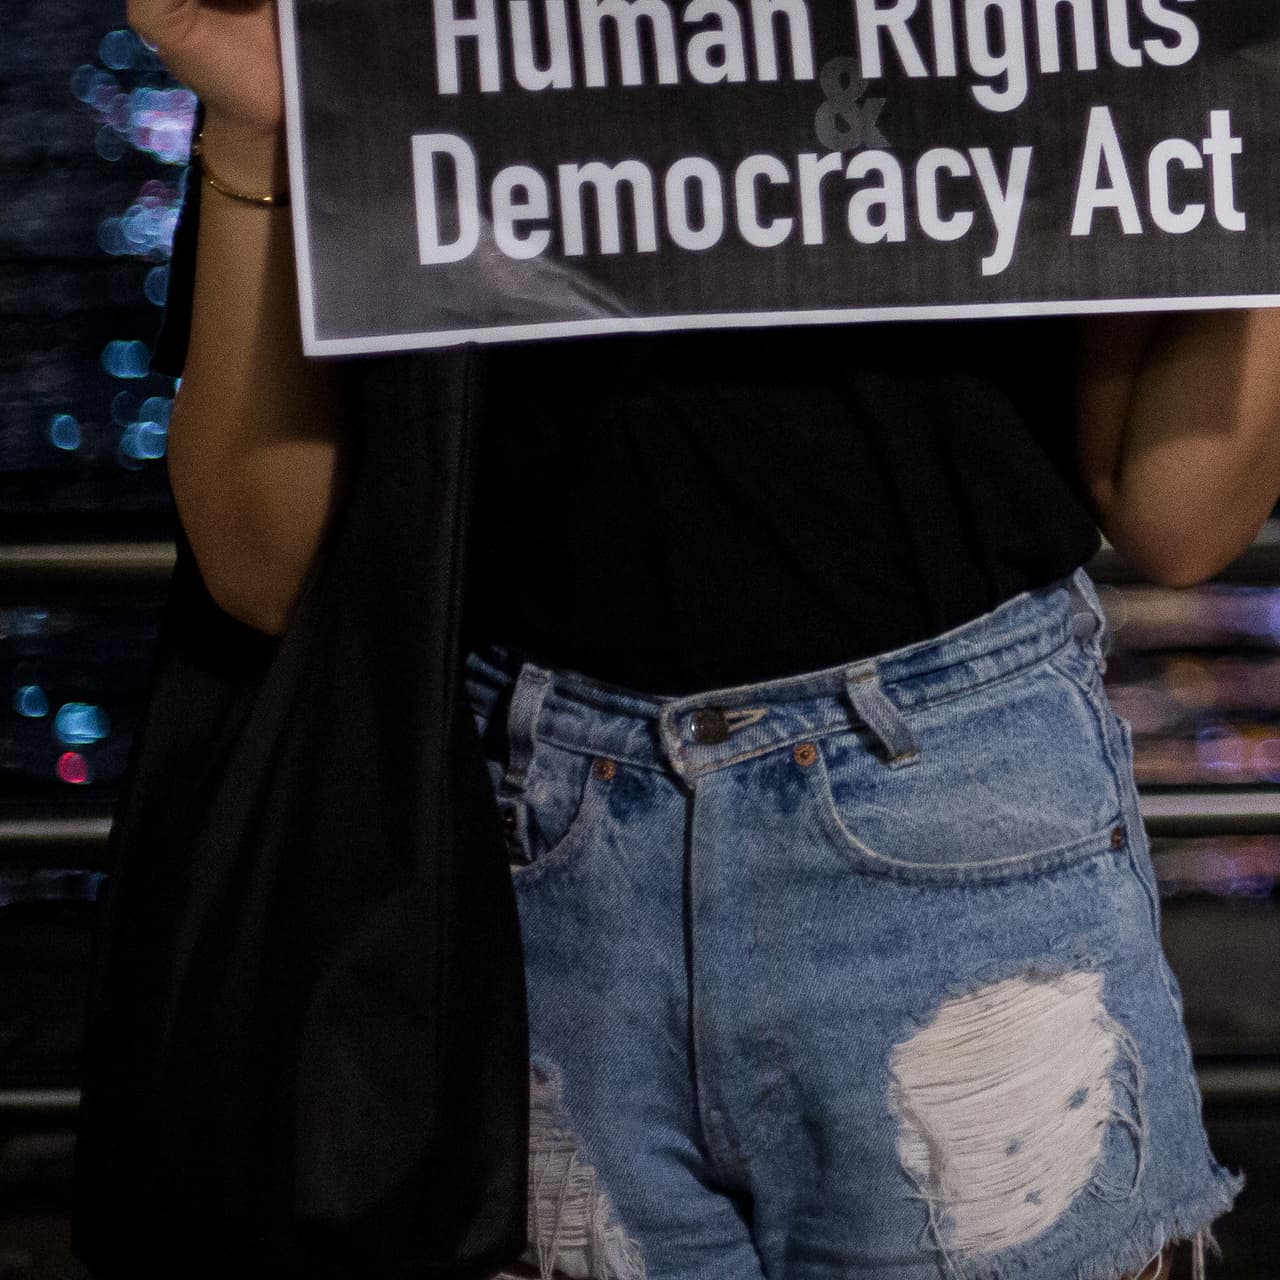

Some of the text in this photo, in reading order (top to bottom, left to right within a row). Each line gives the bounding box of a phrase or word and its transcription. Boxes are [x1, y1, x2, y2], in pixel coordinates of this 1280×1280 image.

[814, 56, 890, 152] &
[410, 104, 1246, 276] Democracy Act
